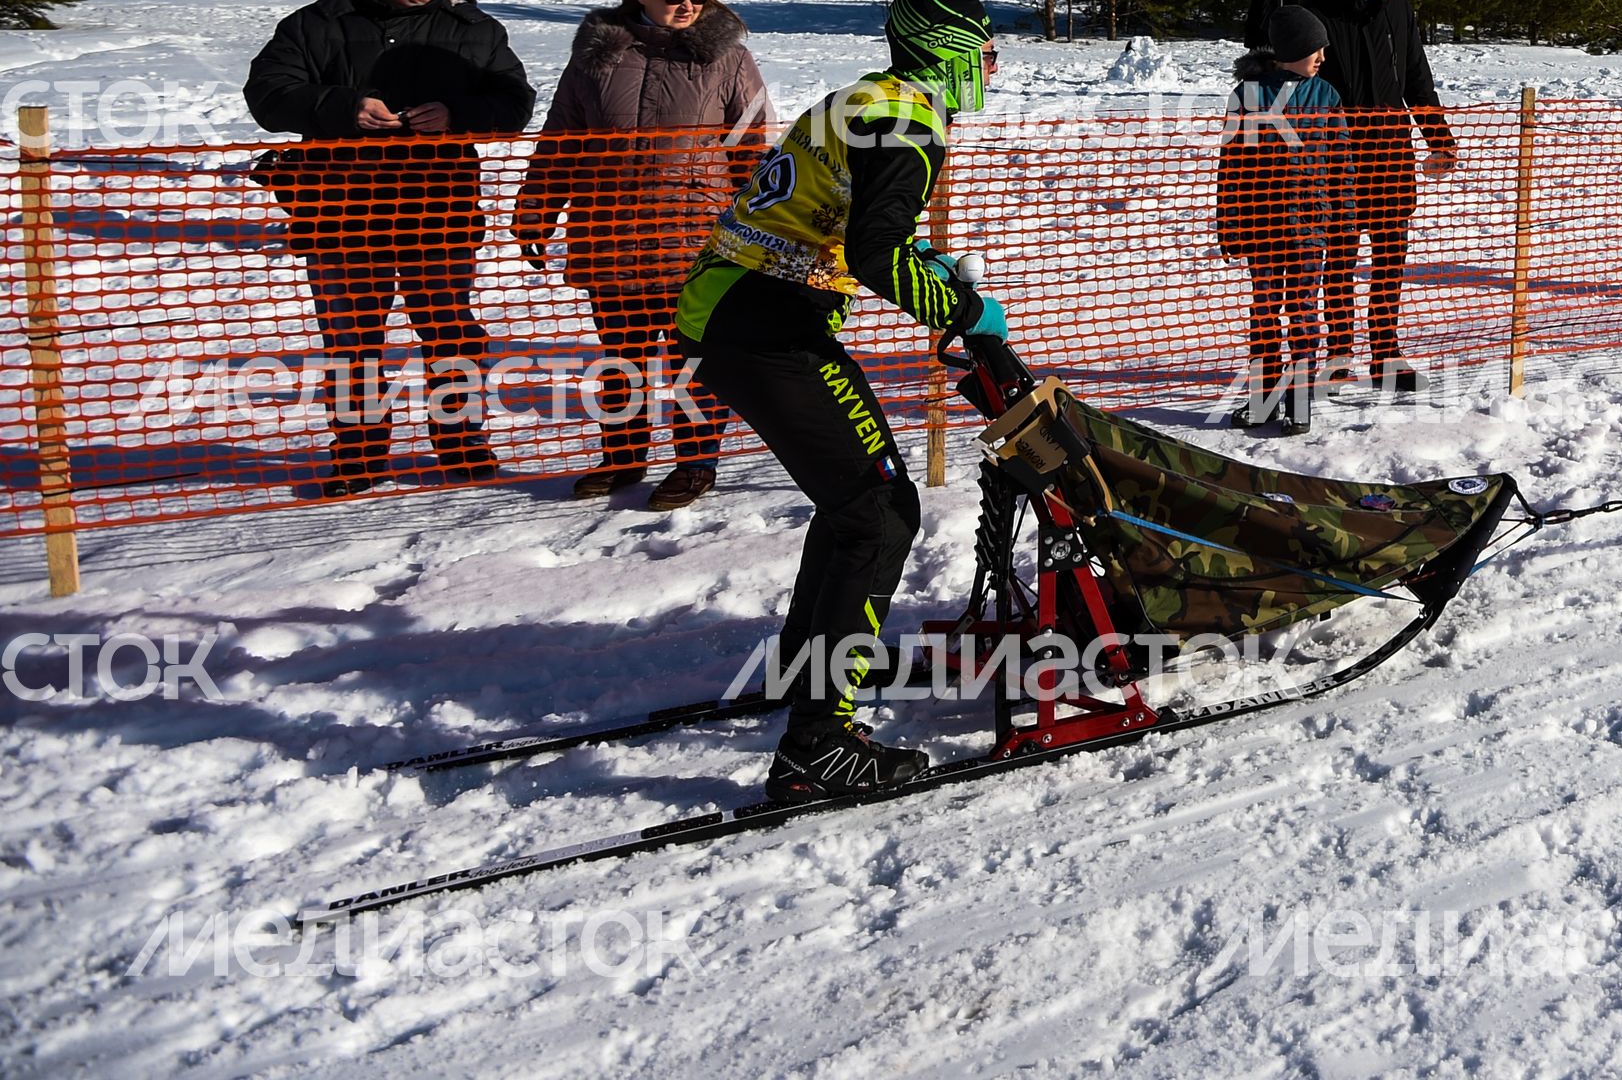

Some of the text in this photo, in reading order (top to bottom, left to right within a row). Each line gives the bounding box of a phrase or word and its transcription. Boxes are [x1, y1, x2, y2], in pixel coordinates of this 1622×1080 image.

[819, 362, 886, 455] RAYVEN
[328, 857, 538, 911] DANLER dogsleds
